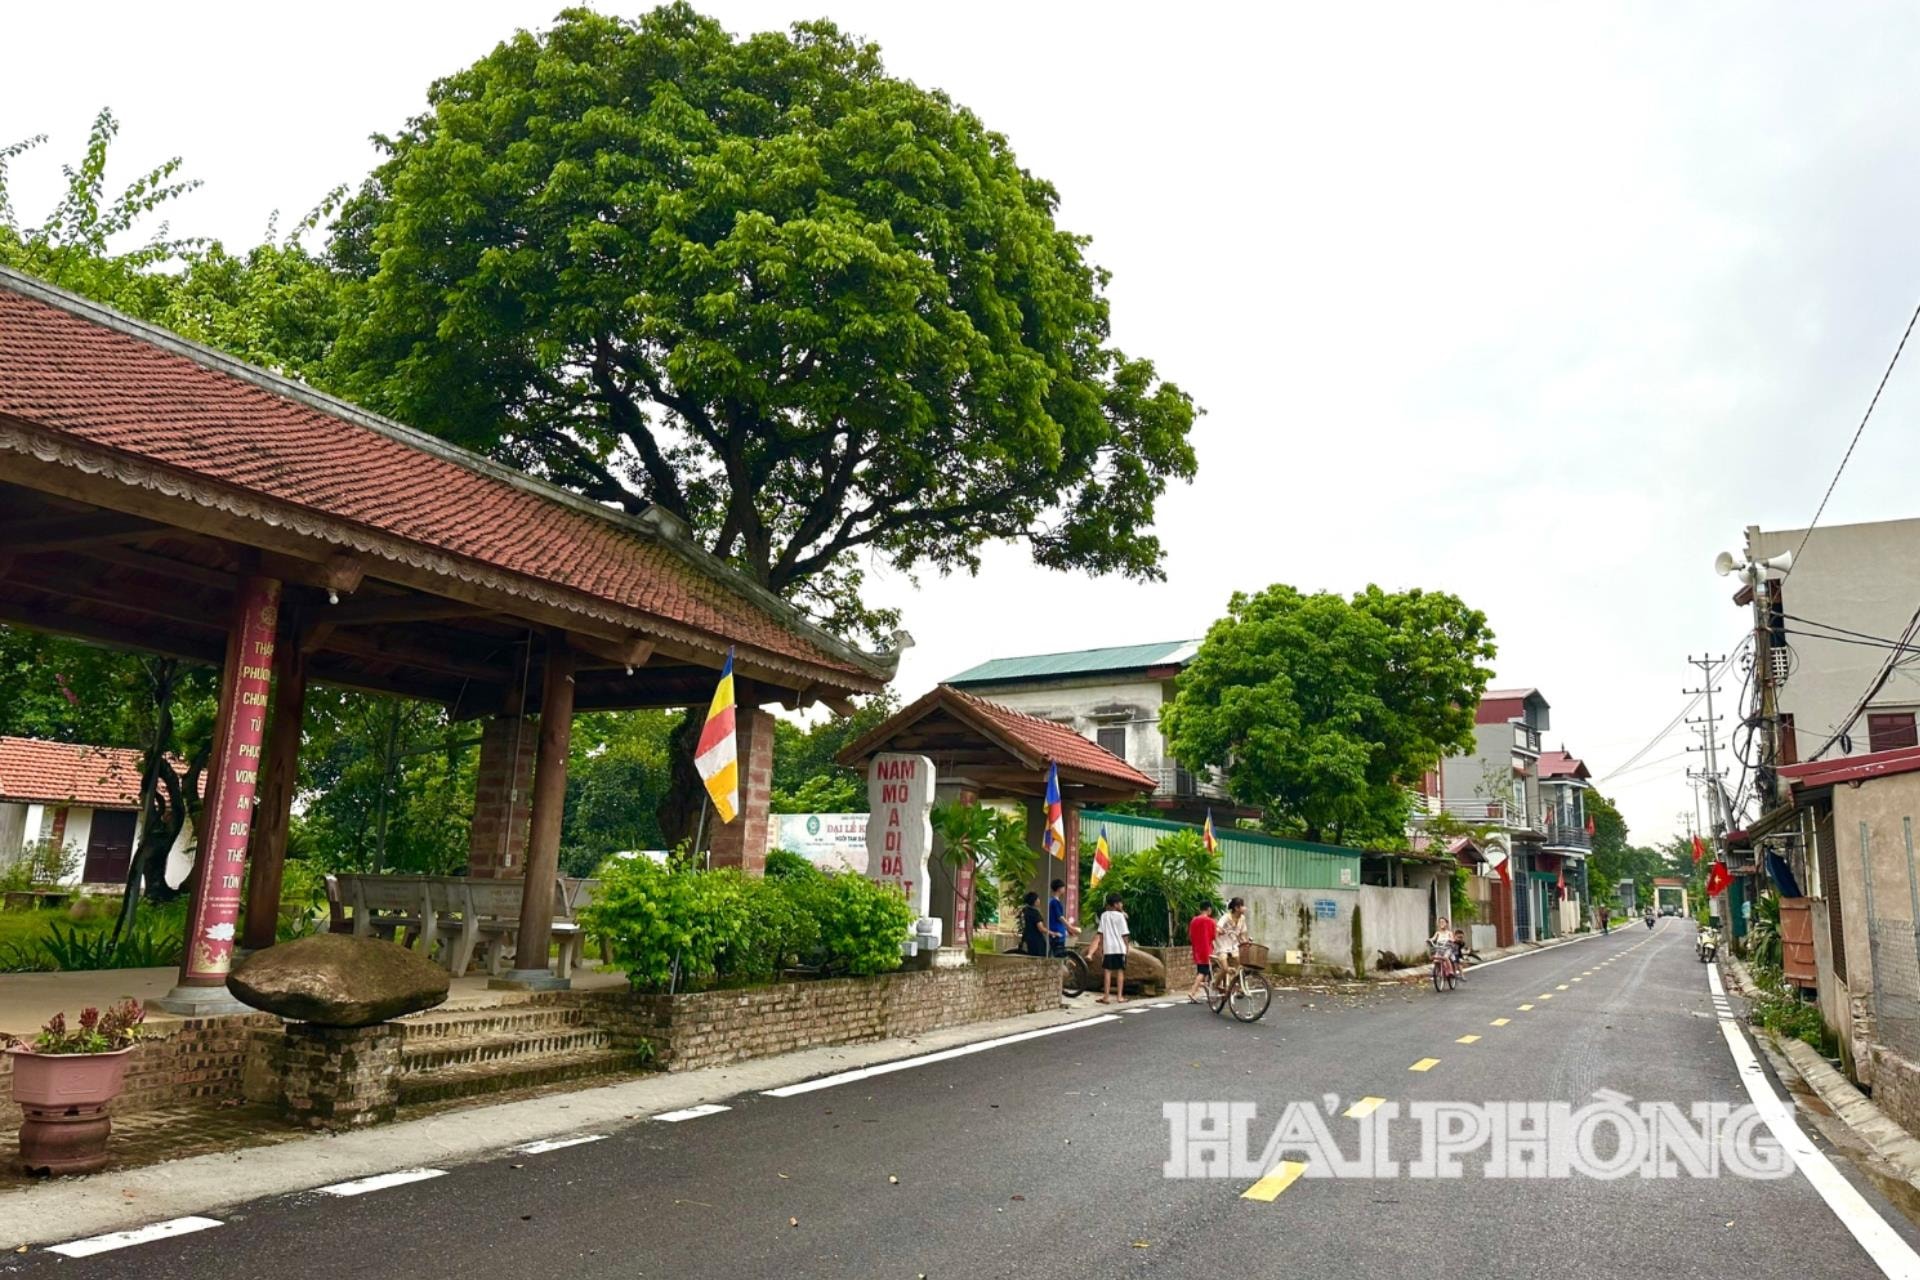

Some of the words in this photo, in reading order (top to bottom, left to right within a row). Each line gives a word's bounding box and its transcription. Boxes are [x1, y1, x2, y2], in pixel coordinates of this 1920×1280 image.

[877, 760, 915, 780] NAM
[882, 781, 909, 803] MÔ
[888, 808, 900, 827] A
